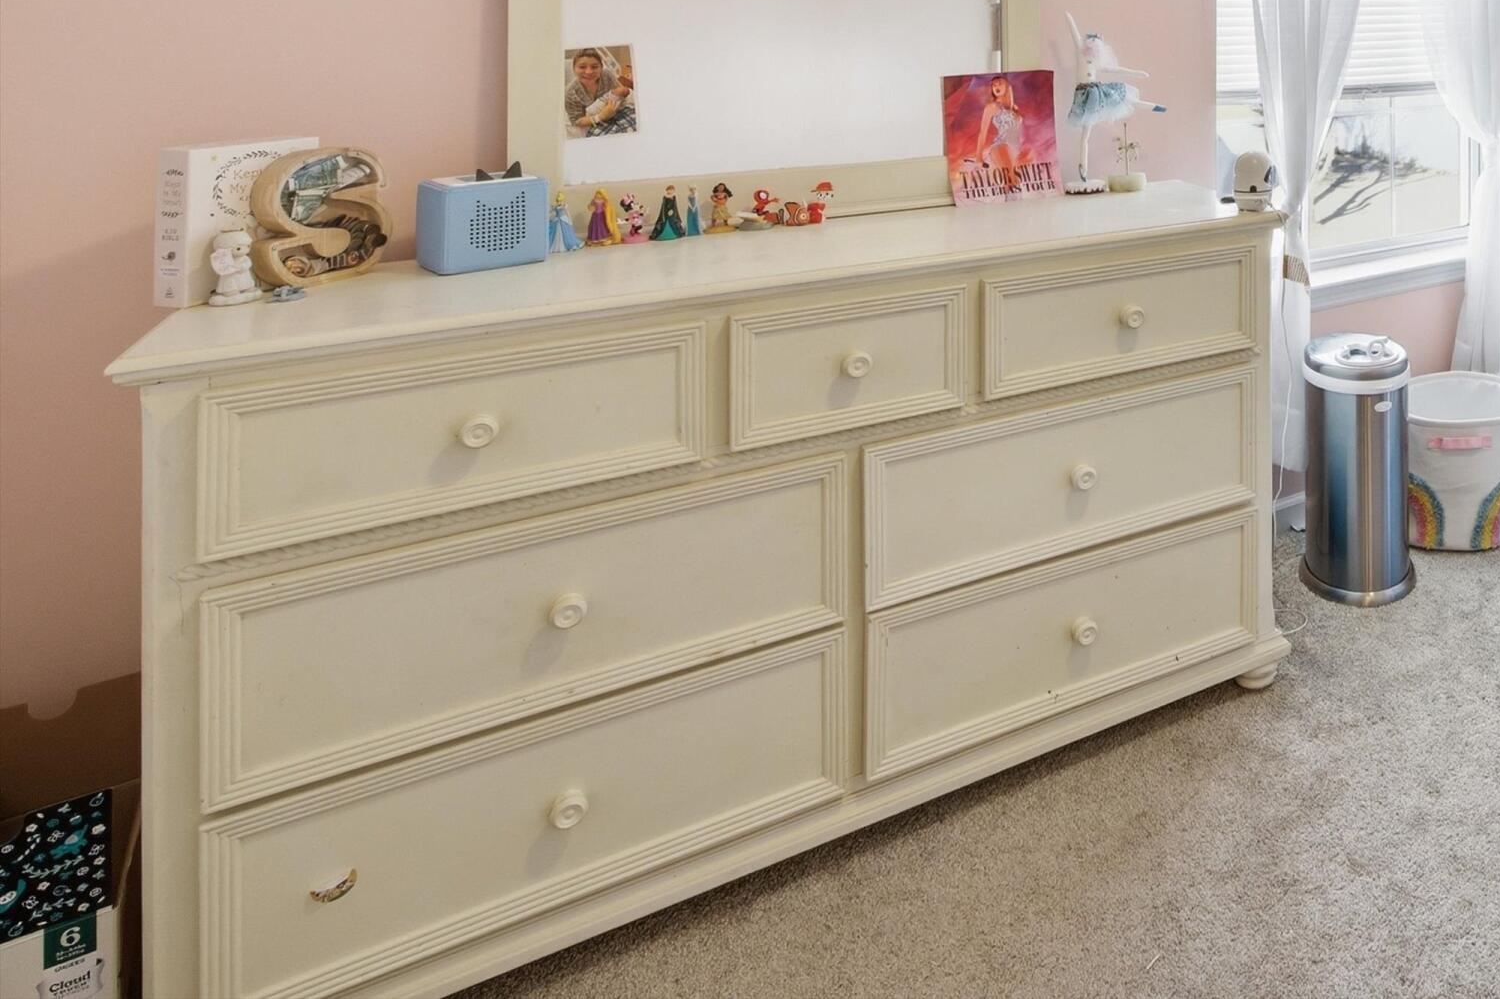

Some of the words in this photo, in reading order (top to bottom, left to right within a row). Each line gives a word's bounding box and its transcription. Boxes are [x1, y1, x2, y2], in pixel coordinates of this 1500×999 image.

[960, 166, 1012, 189] TAYLOR
[1013, 162, 1052, 183] SWIFT
[963, 188, 989, 199] THE
[991, 185, 1022, 197] ERAS
[1023, 180, 1055, 192] TOUR
[60, 926, 81, 948] 6
